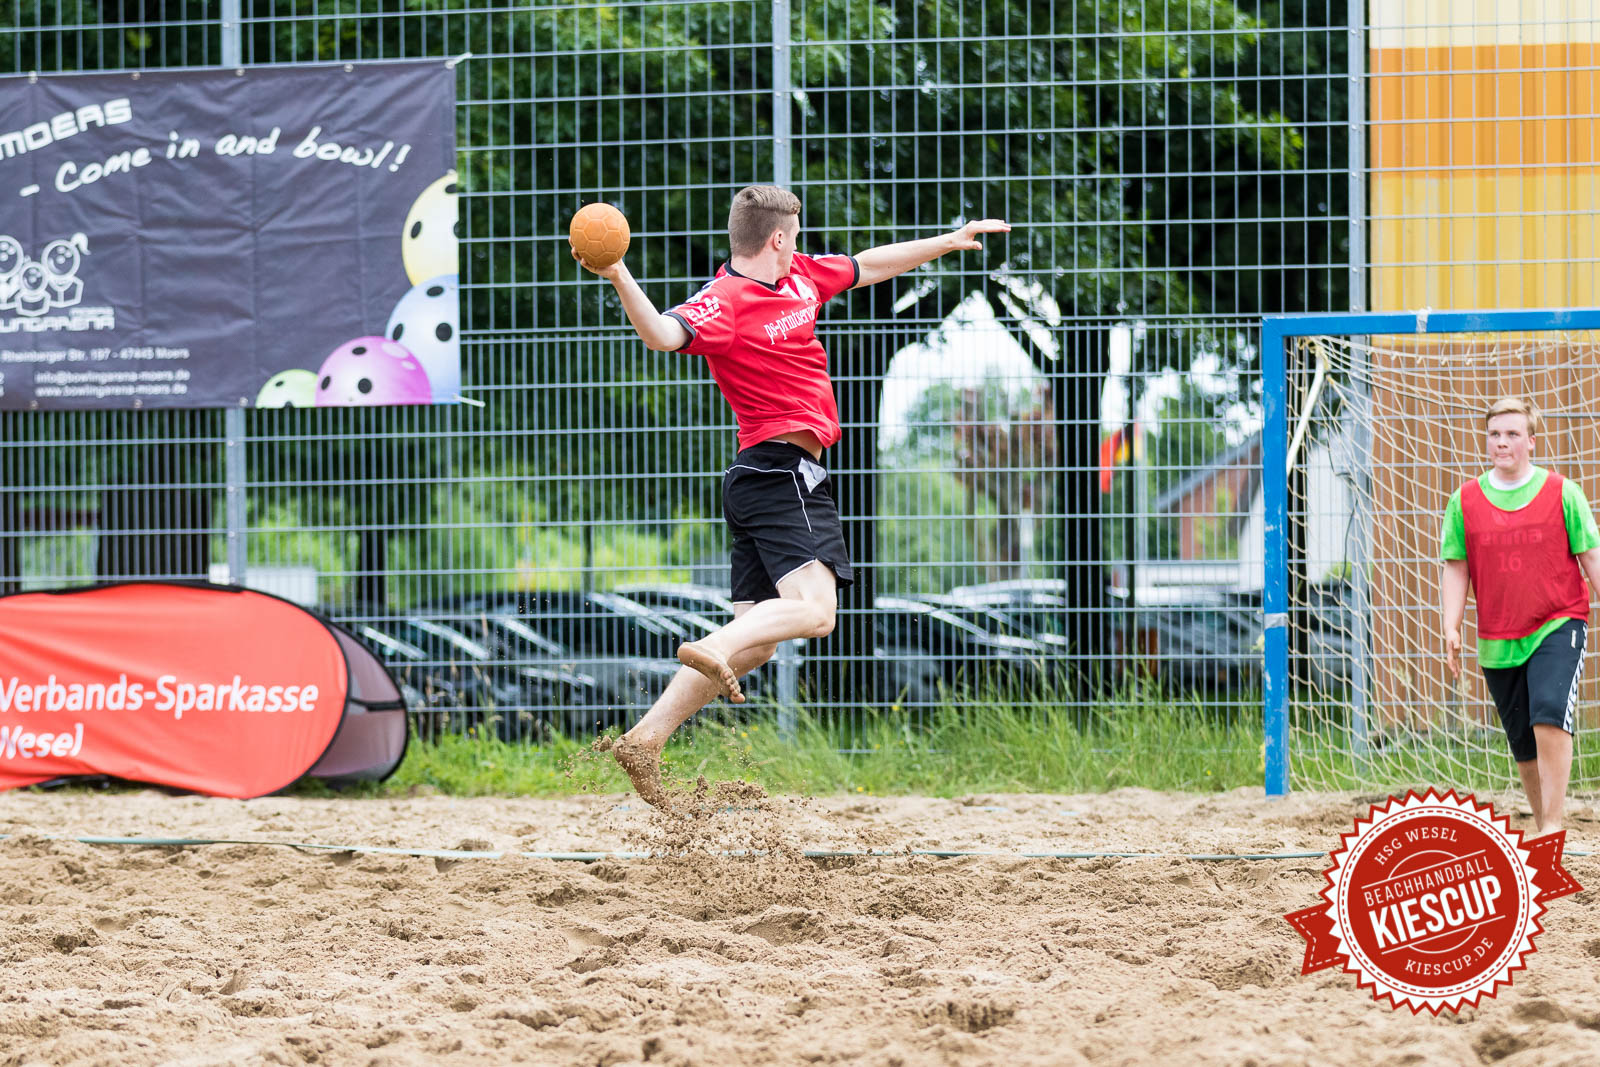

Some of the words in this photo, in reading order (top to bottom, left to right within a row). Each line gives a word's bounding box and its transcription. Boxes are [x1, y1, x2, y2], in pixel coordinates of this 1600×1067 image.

[55, 147, 152, 193] Come
[166, 131, 200, 160] in
[215, 127, 281, 157] and
[293, 126, 412, 172] bowl!
[1497, 550, 1522, 572] 16
[0, 674, 319, 720] Verbands-Sparkasse
